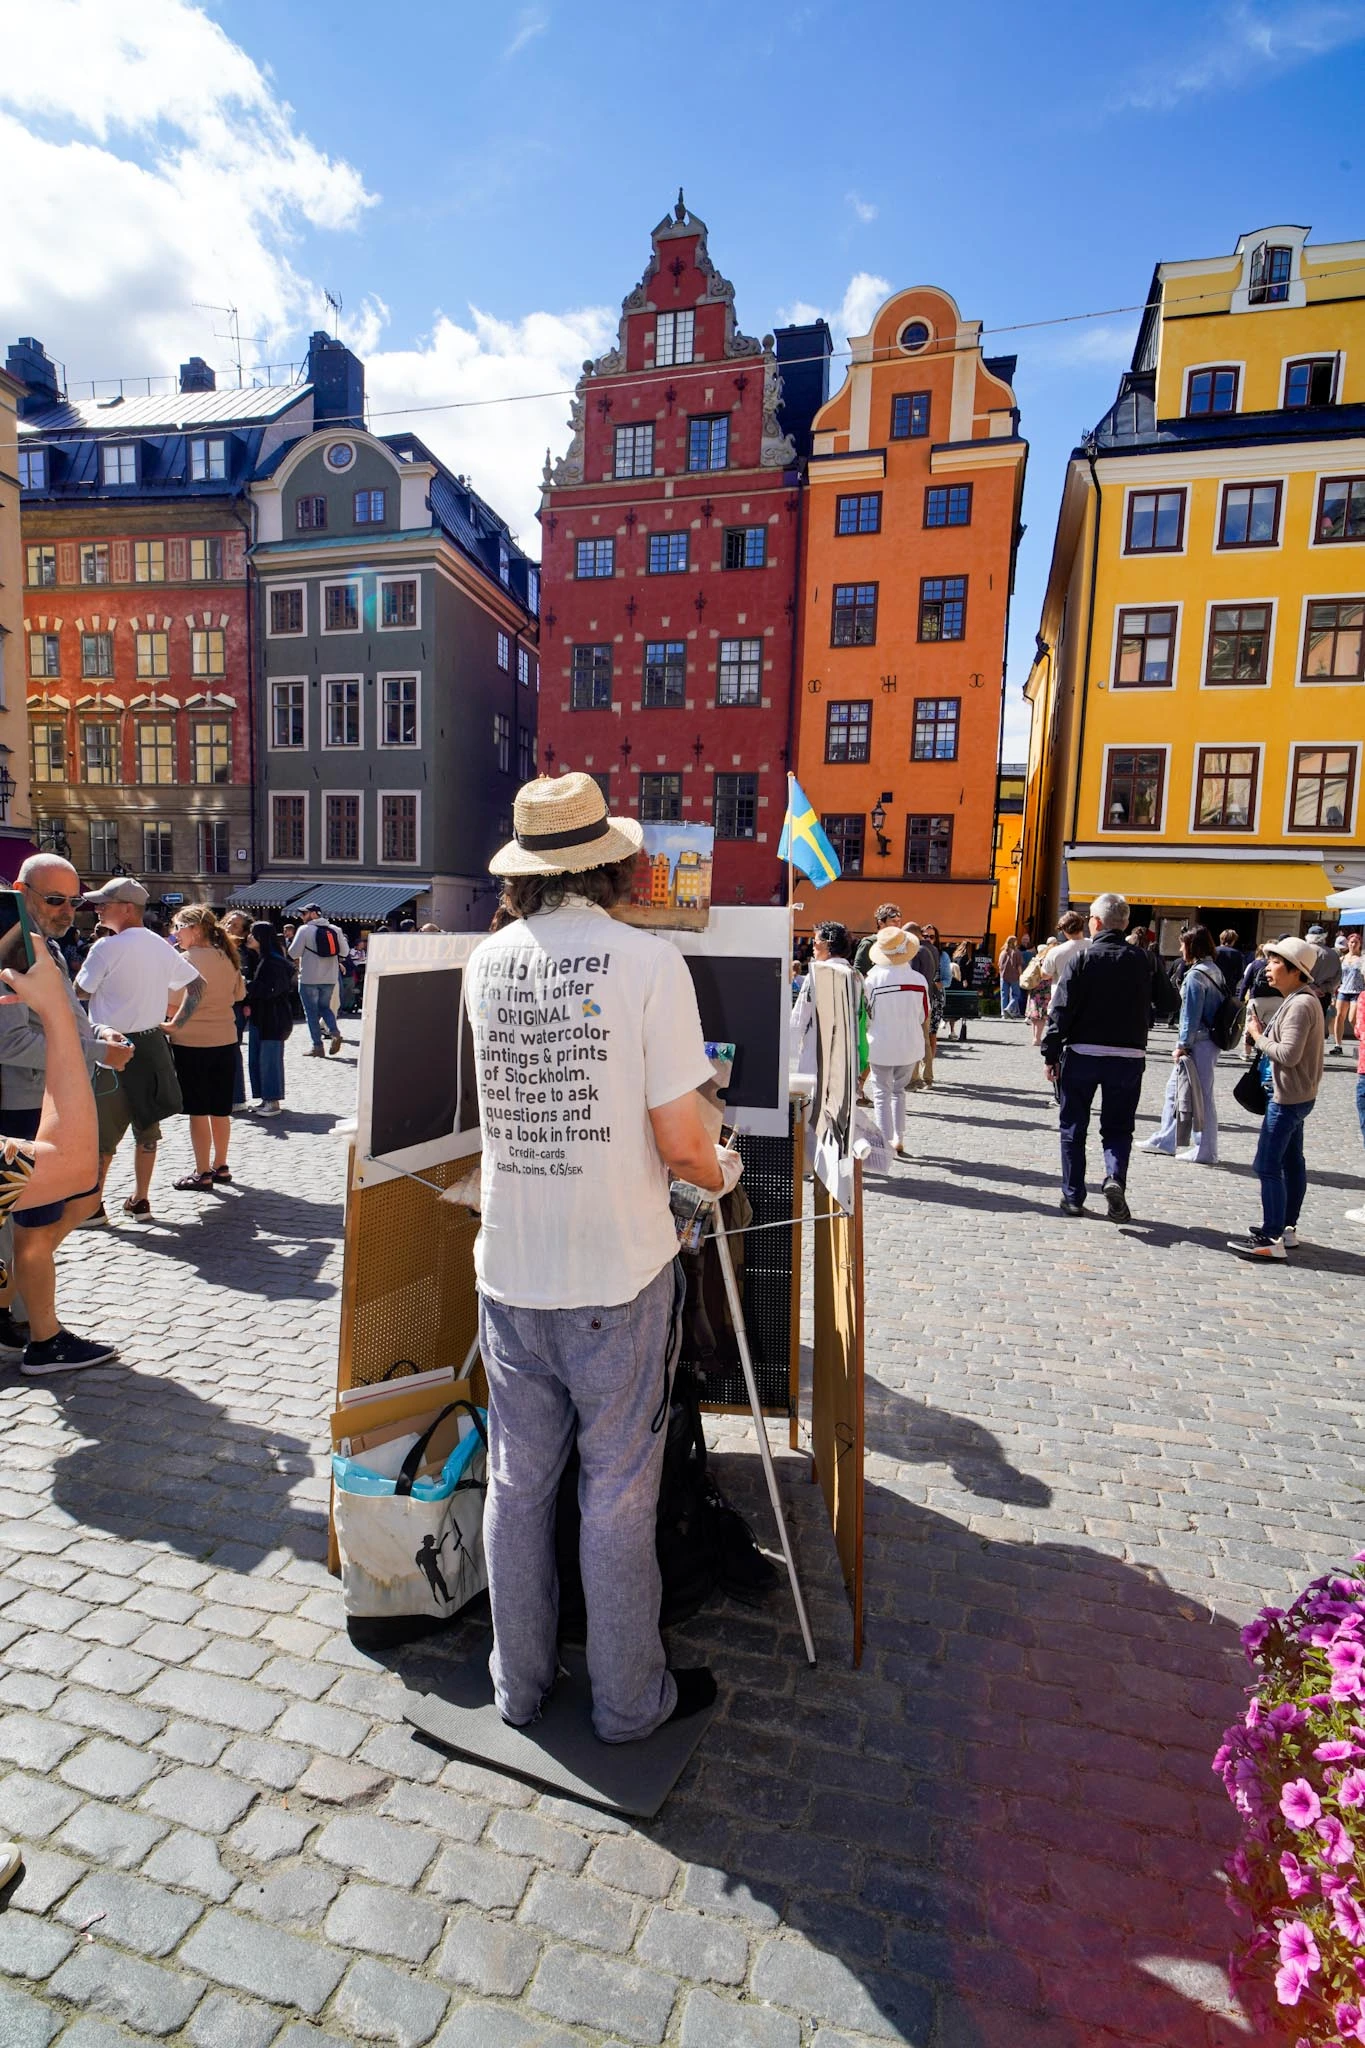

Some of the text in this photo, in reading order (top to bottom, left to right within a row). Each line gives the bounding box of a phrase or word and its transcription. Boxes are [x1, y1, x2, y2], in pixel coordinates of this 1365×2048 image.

[477, 953, 610, 981] Hello there!
[481, 980, 595, 1005] I'm Tim, i offer
[497, 1004, 571, 1026] ORIGINAL
[488, 1028, 515, 1045] and
[520, 1022, 610, 1046] watercolor
[478, 1044, 608, 1069] aintings & prints
[484, 1066, 590, 1085] of Stockholm.
[515, 1086, 547, 1105] free
[551, 1087, 563, 1102] to
[568, 1084, 600, 1102] ask
[486, 1104, 591, 1123] questions and
[505, 1128, 513, 1140] a
[517, 1125, 548, 1143] look
[551, 1126, 562, 1142] in
[565, 1126, 611, 1143] front!
[508, 1145, 566, 1160] Credit-cards
